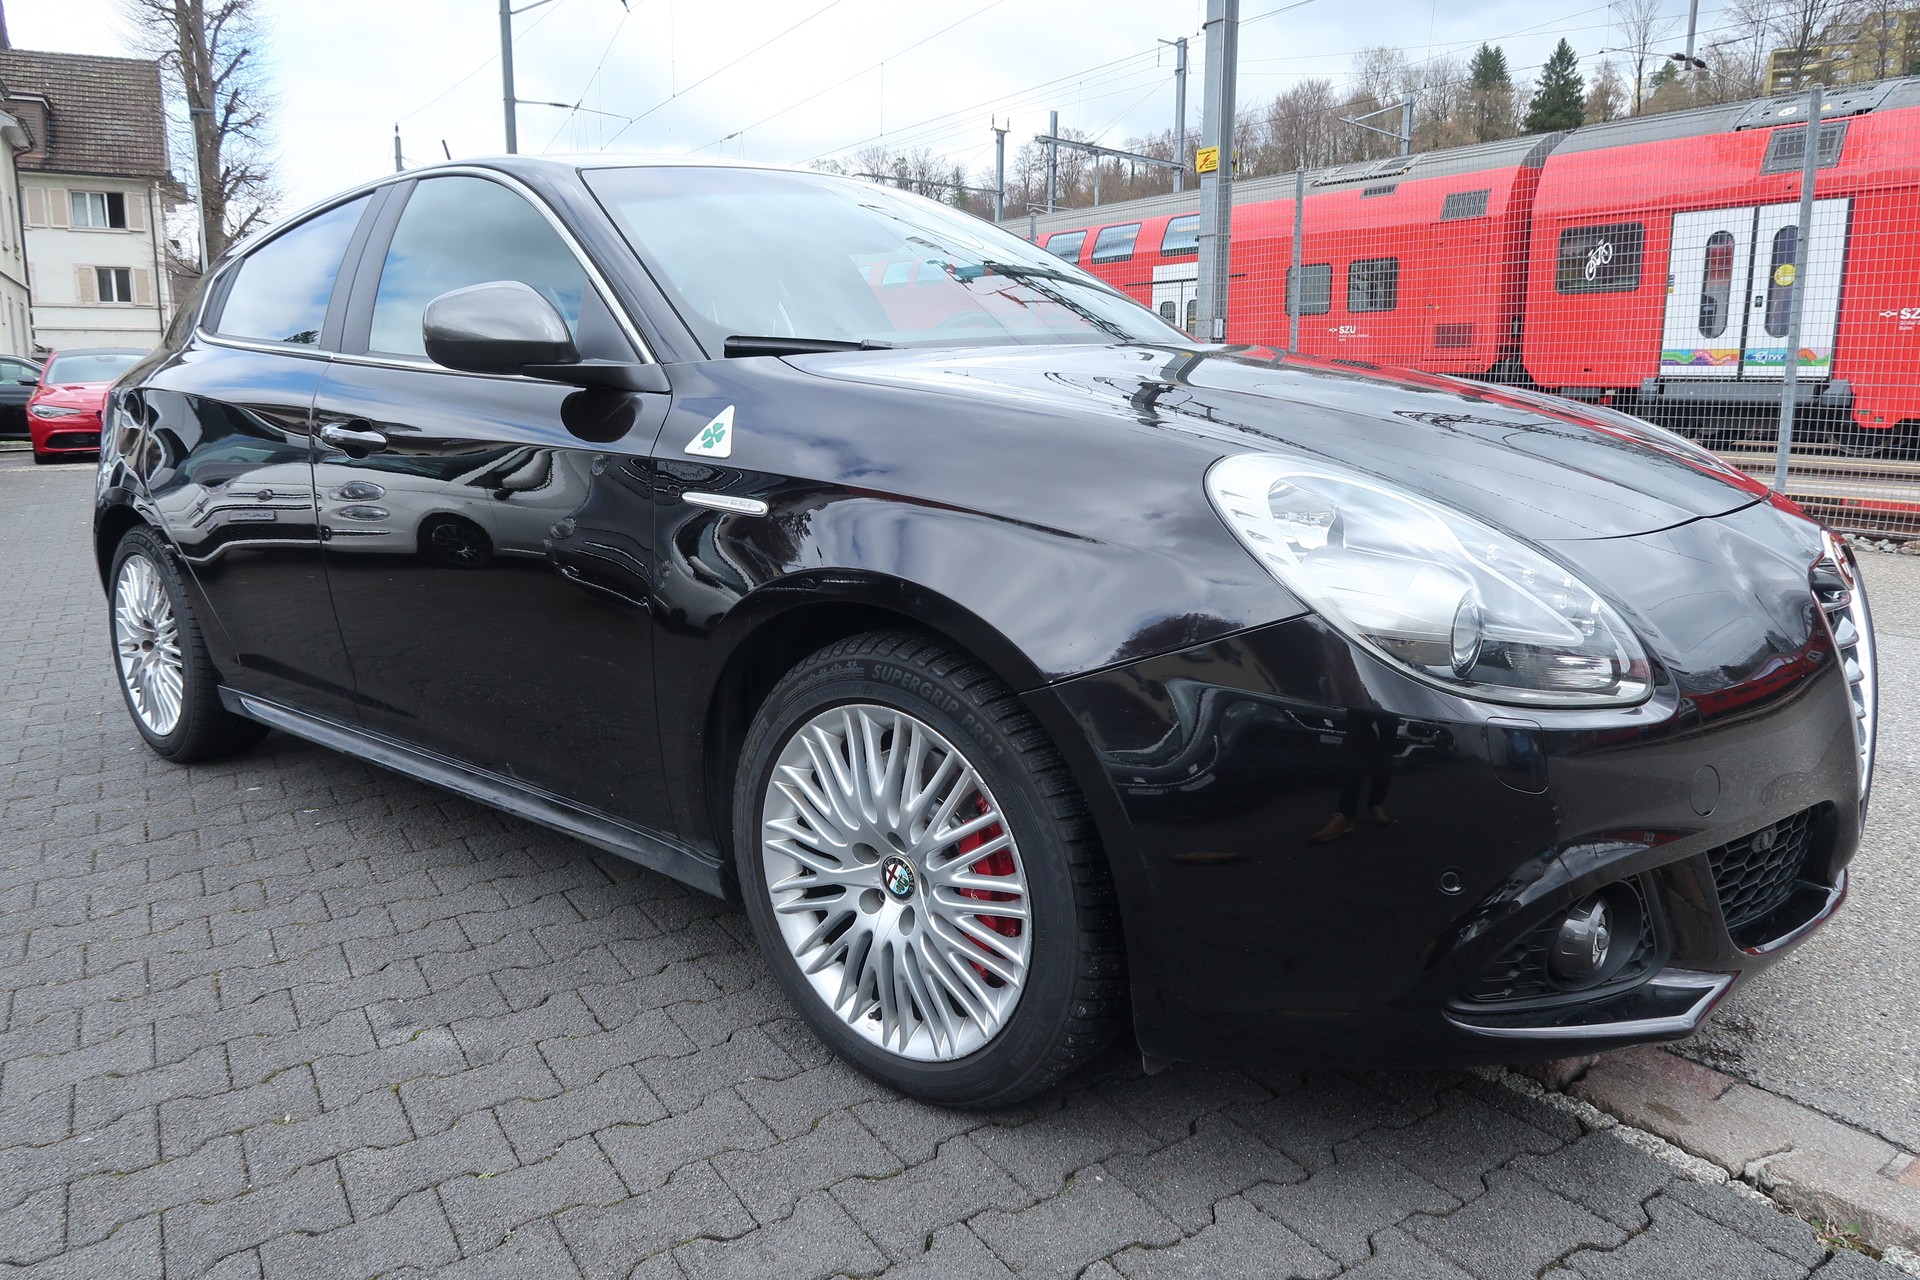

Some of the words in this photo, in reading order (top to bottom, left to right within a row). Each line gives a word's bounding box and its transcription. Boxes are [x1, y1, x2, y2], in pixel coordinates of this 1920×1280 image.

[1338, 325, 1357, 334] SZU
[872, 664, 959, 713] SUPERGRIP
[961, 713, 993, 748] PRO
[902, 862, 914, 892] ROMEO
